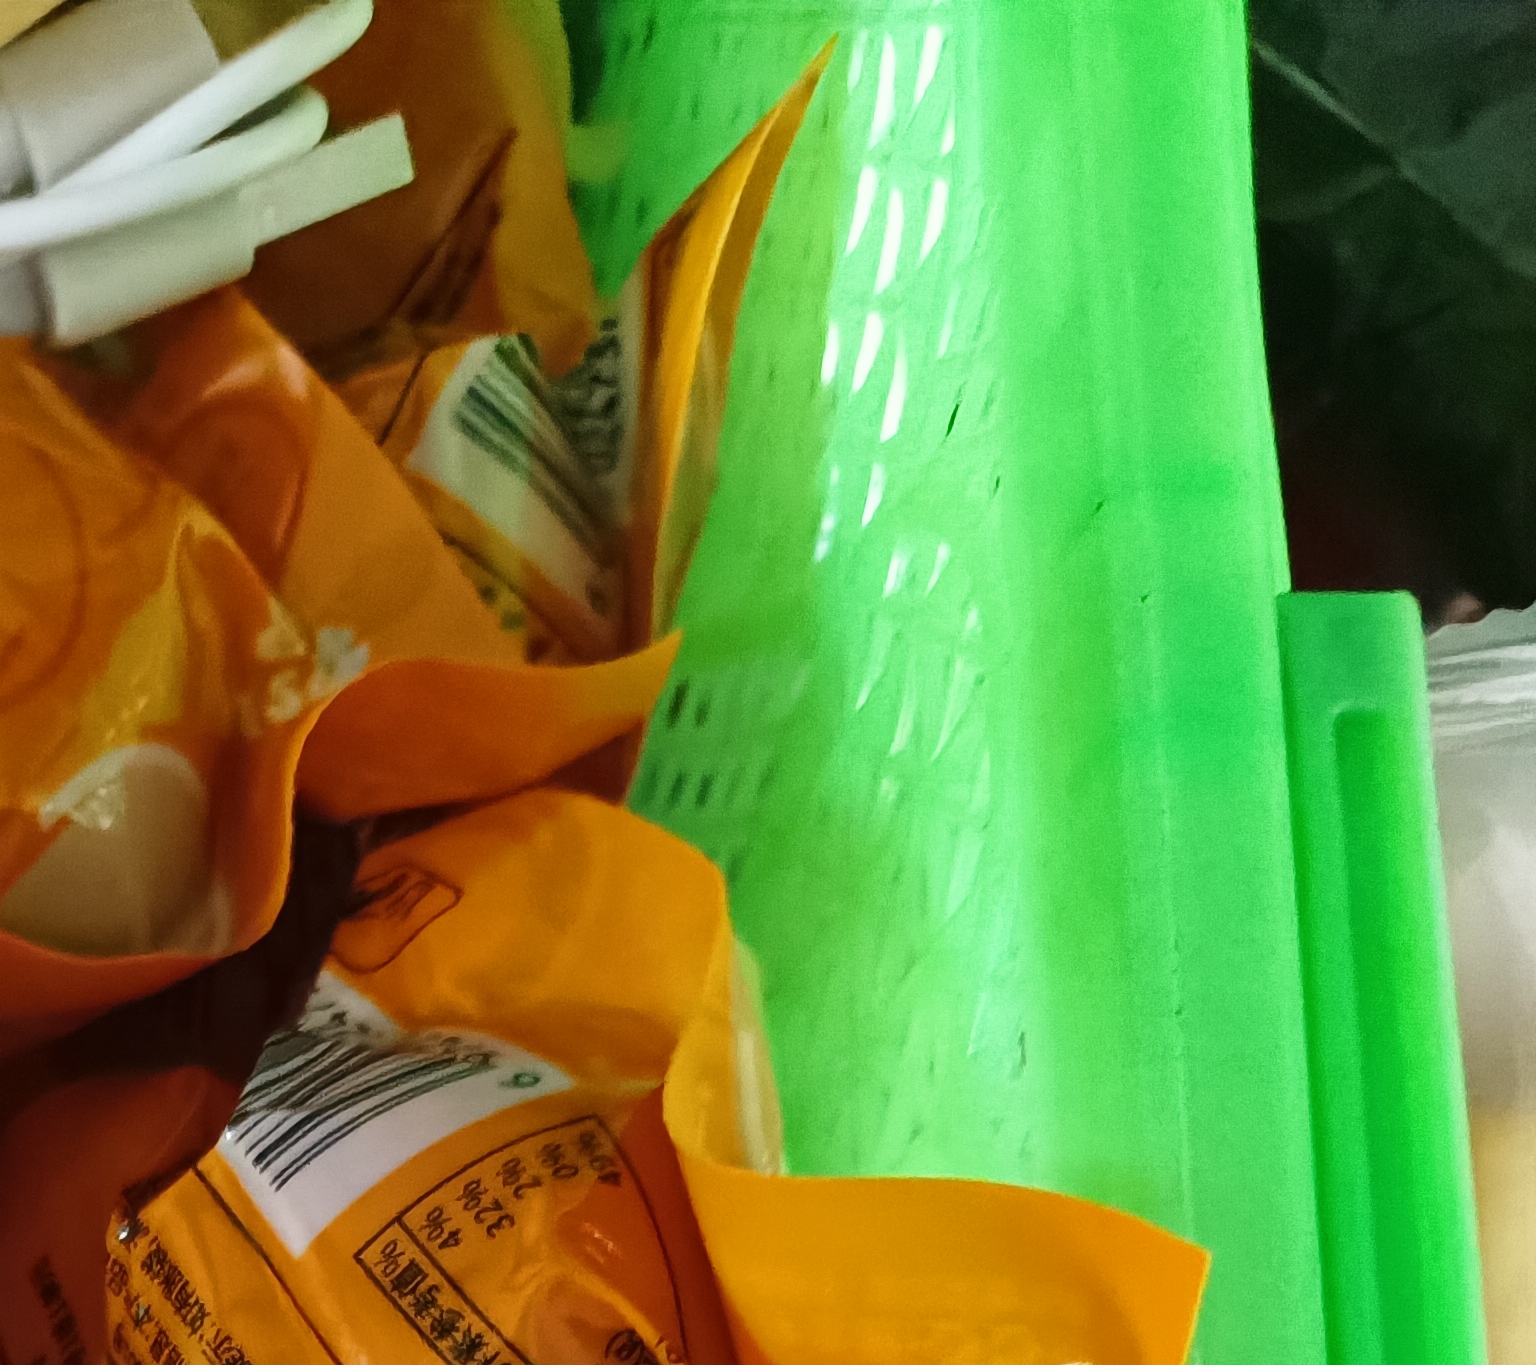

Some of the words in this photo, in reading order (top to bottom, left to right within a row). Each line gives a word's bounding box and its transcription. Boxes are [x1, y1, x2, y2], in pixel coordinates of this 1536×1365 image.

[495, 1157, 543, 1201] 2%
[418, 1205, 462, 1251] 4%
[455, 1178, 516, 1239] 32%
